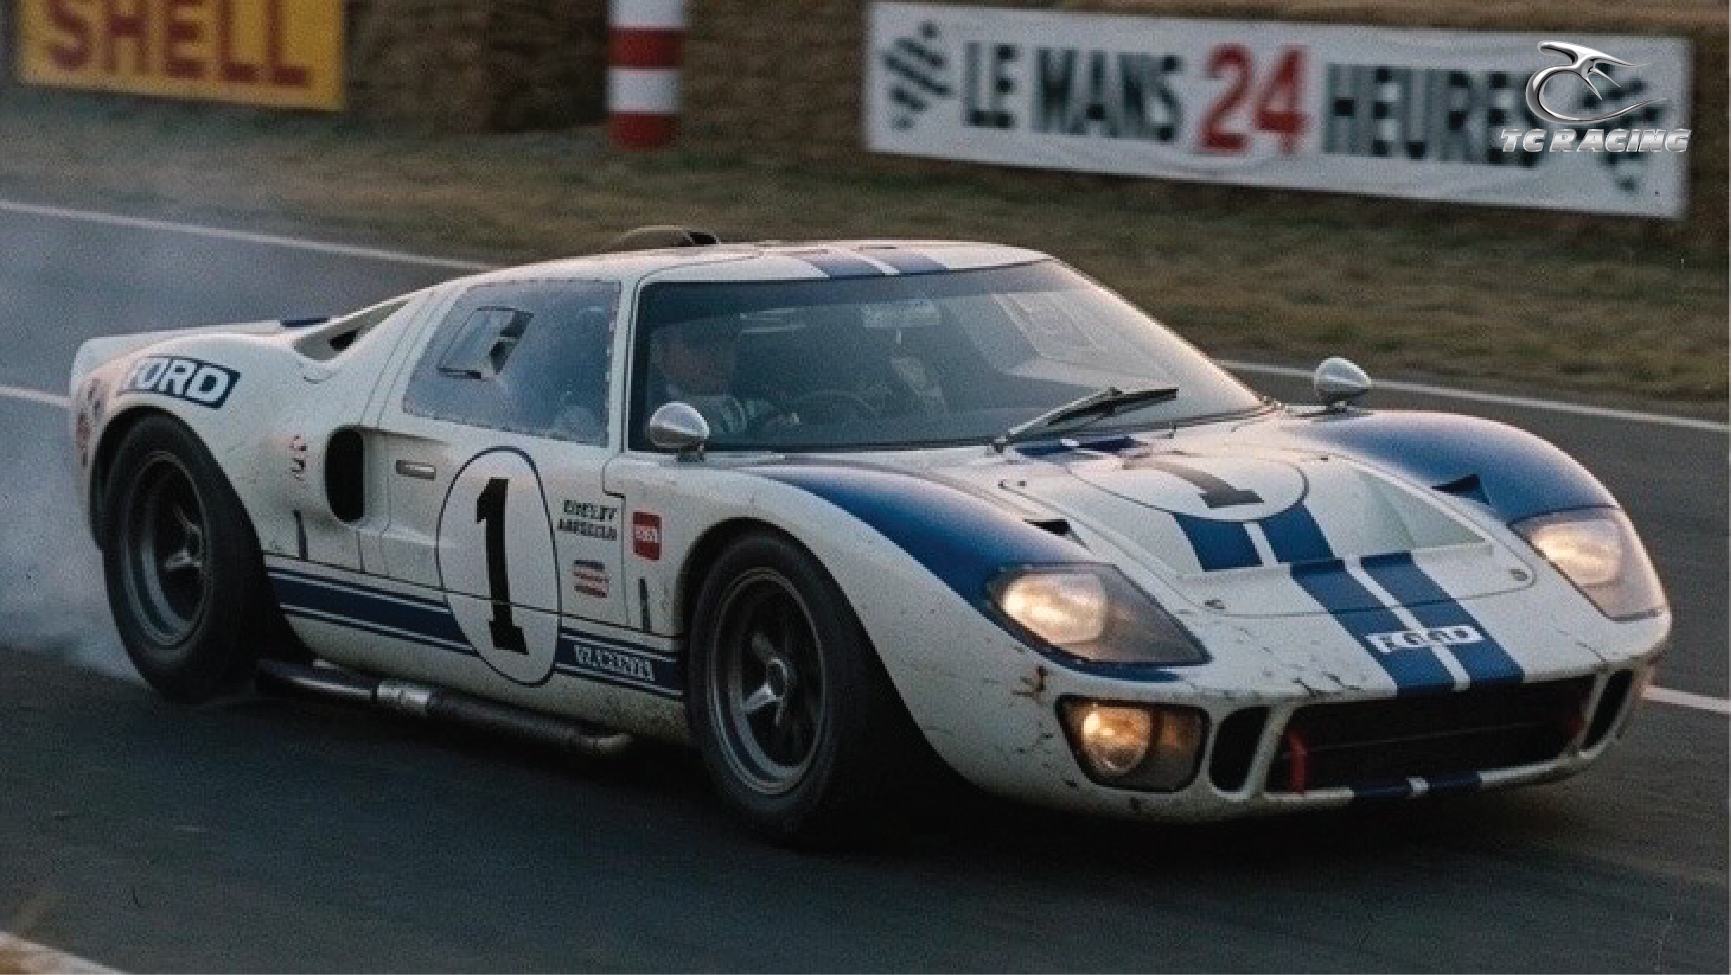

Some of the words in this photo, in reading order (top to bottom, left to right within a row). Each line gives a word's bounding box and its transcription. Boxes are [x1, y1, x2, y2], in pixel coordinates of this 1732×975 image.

[46, 0, 311, 87] SHELL
[963, 39, 1016, 130] LE
[1033, 46, 1182, 144] MANS
[1197, 44, 1312, 158] 24
[1122, 459, 1265, 509] 1
[476, 477, 529, 655] 1
